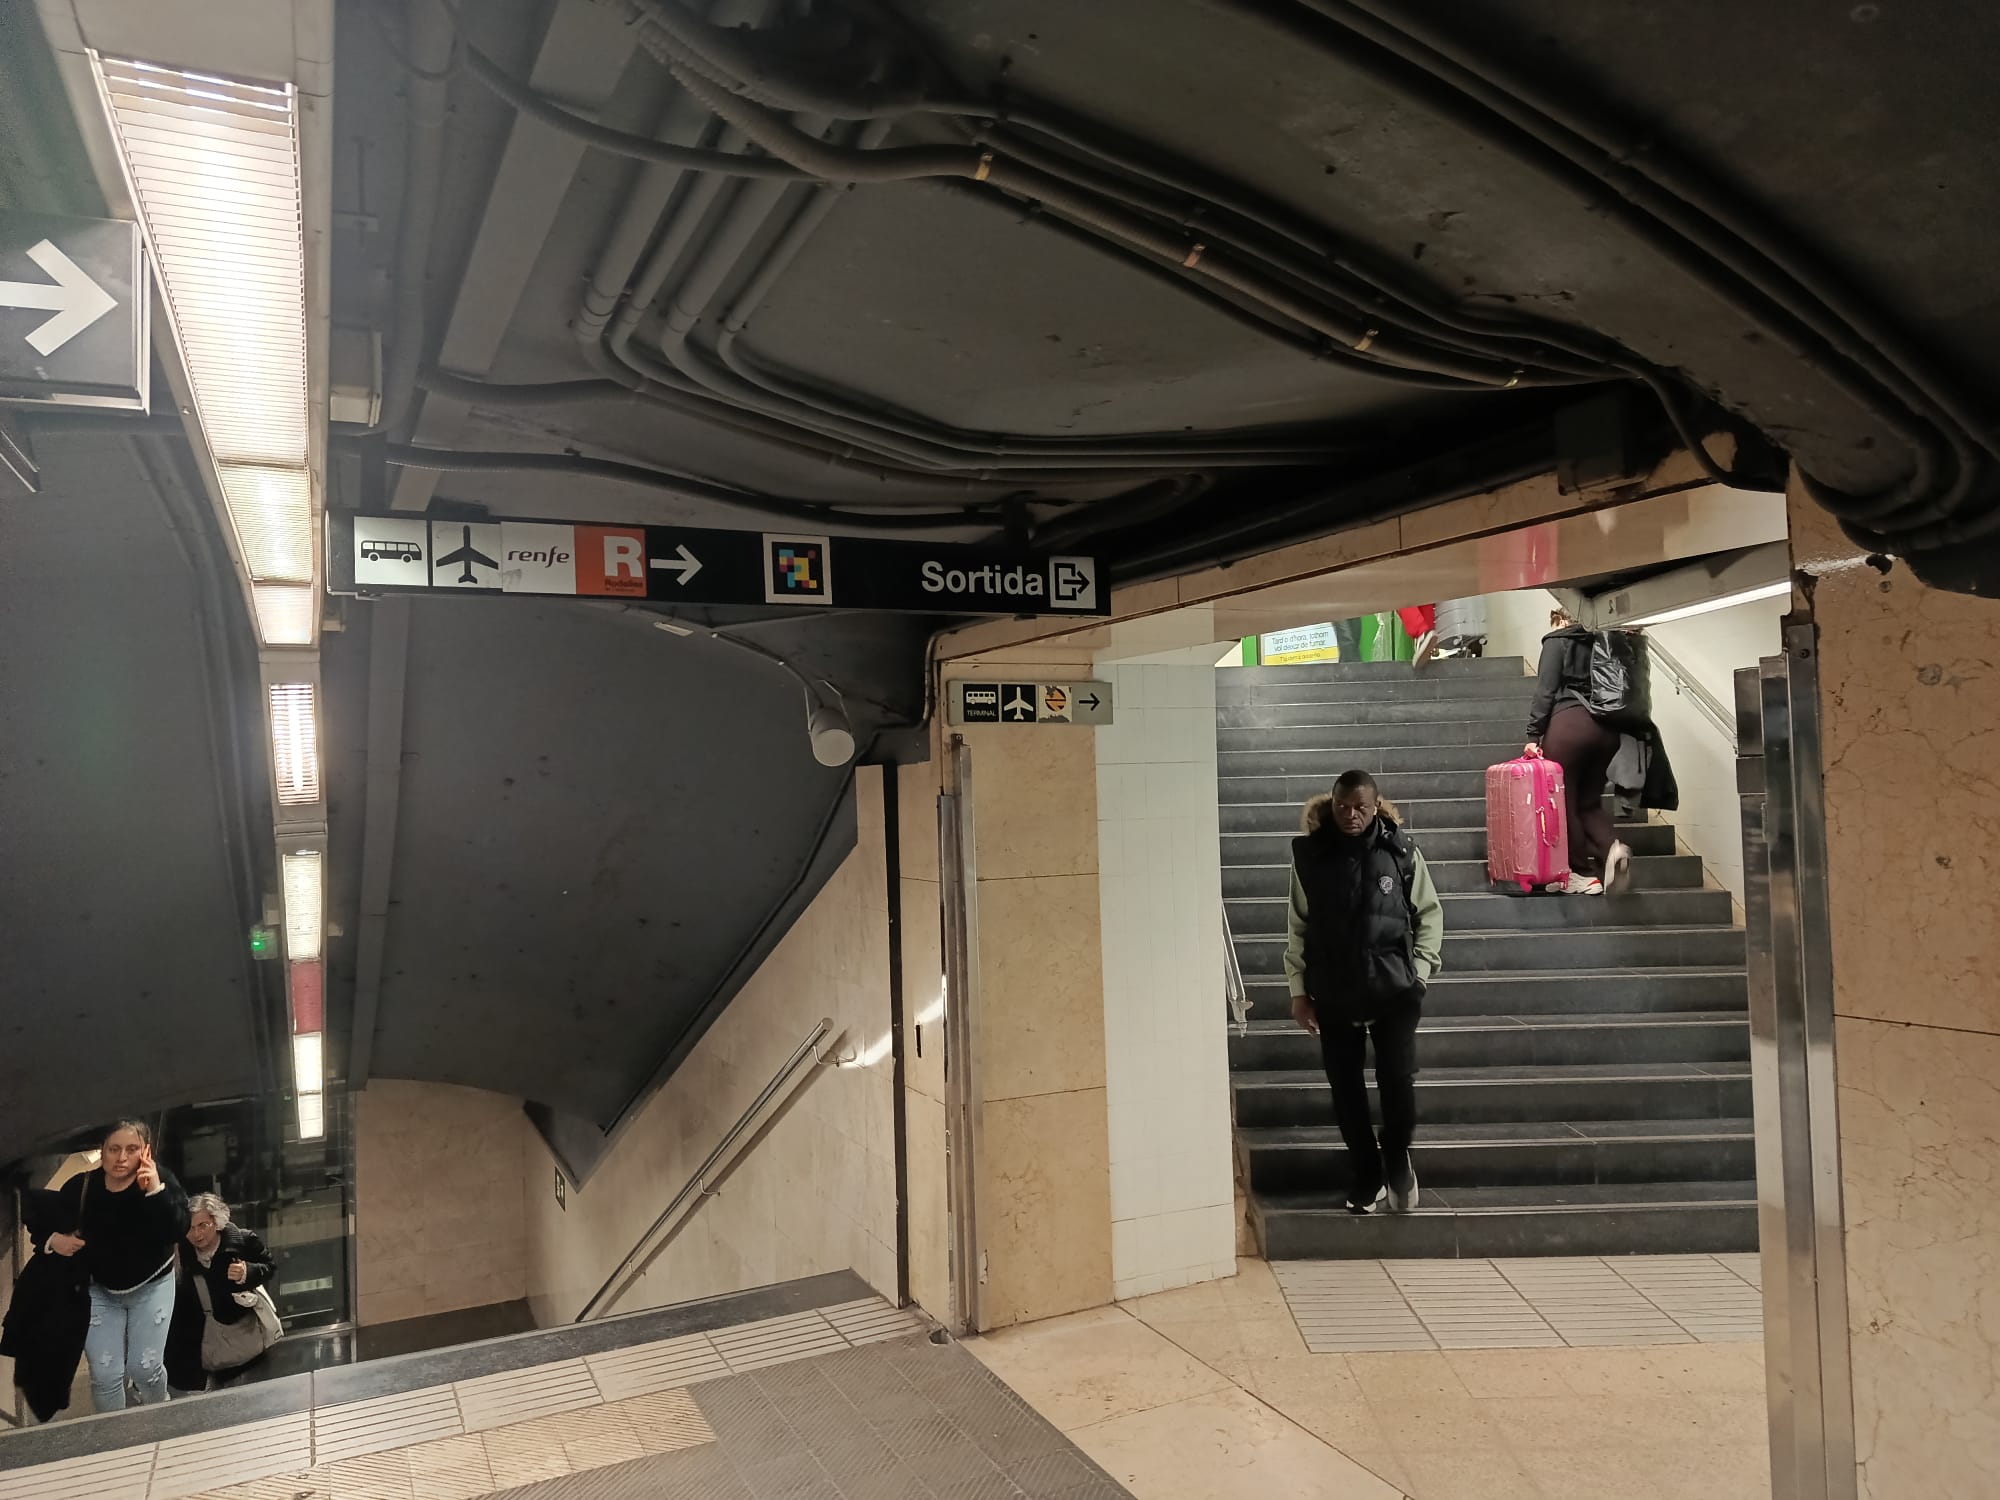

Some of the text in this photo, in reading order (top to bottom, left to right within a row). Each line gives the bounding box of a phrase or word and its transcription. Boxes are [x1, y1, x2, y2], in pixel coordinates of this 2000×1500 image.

[507, 545, 570, 568] renfe
[603, 535, 644, 578] R
[921, 560, 1044, 596] Sortida
[967, 709, 997, 717] TERMINAL
